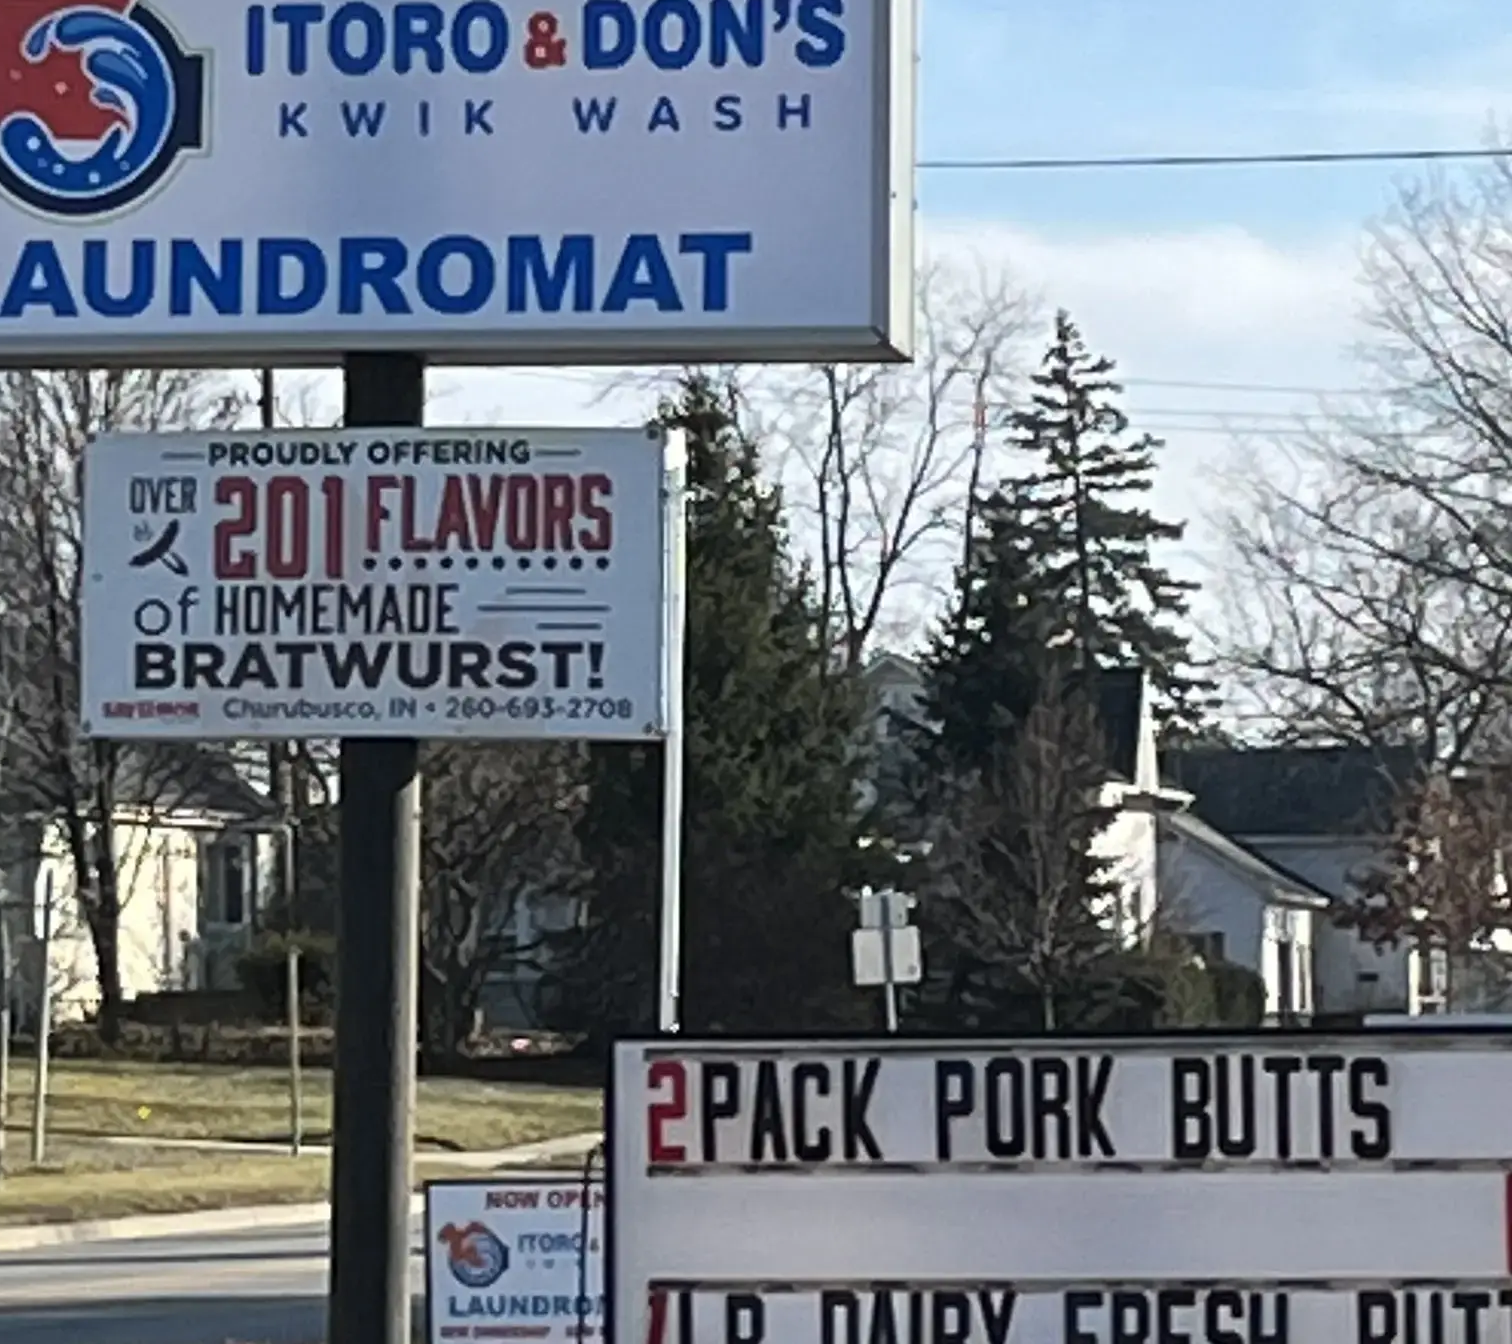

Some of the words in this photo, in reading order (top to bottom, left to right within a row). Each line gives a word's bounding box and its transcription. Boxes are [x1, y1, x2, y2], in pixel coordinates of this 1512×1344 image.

[245, 1, 510, 77] ITORO
[523, 11, 567, 68] &
[279, 99, 496, 138] KWIK
[574, 94, 812, 133] WASH
[208, 441, 358, 467] PROUDLY
[367, 439, 532, 465] OFFERING
[129, 477, 197, 513] OVER
[213, 475, 345, 581] 201
[364, 474, 613, 553] FLAVORS
[134, 585, 200, 636] of
[214, 583, 460, 636] HOMEMADE
[134, 641, 605, 690] BRATWURST!
[223, 697, 381, 721] Churubusco,
[390, 699, 417, 718] IN
[445, 697, 634, 719] 260-693-2708
[935, 1056, 1117, 1162] PORK
[1172, 1056, 1392, 1160] BUTTS
